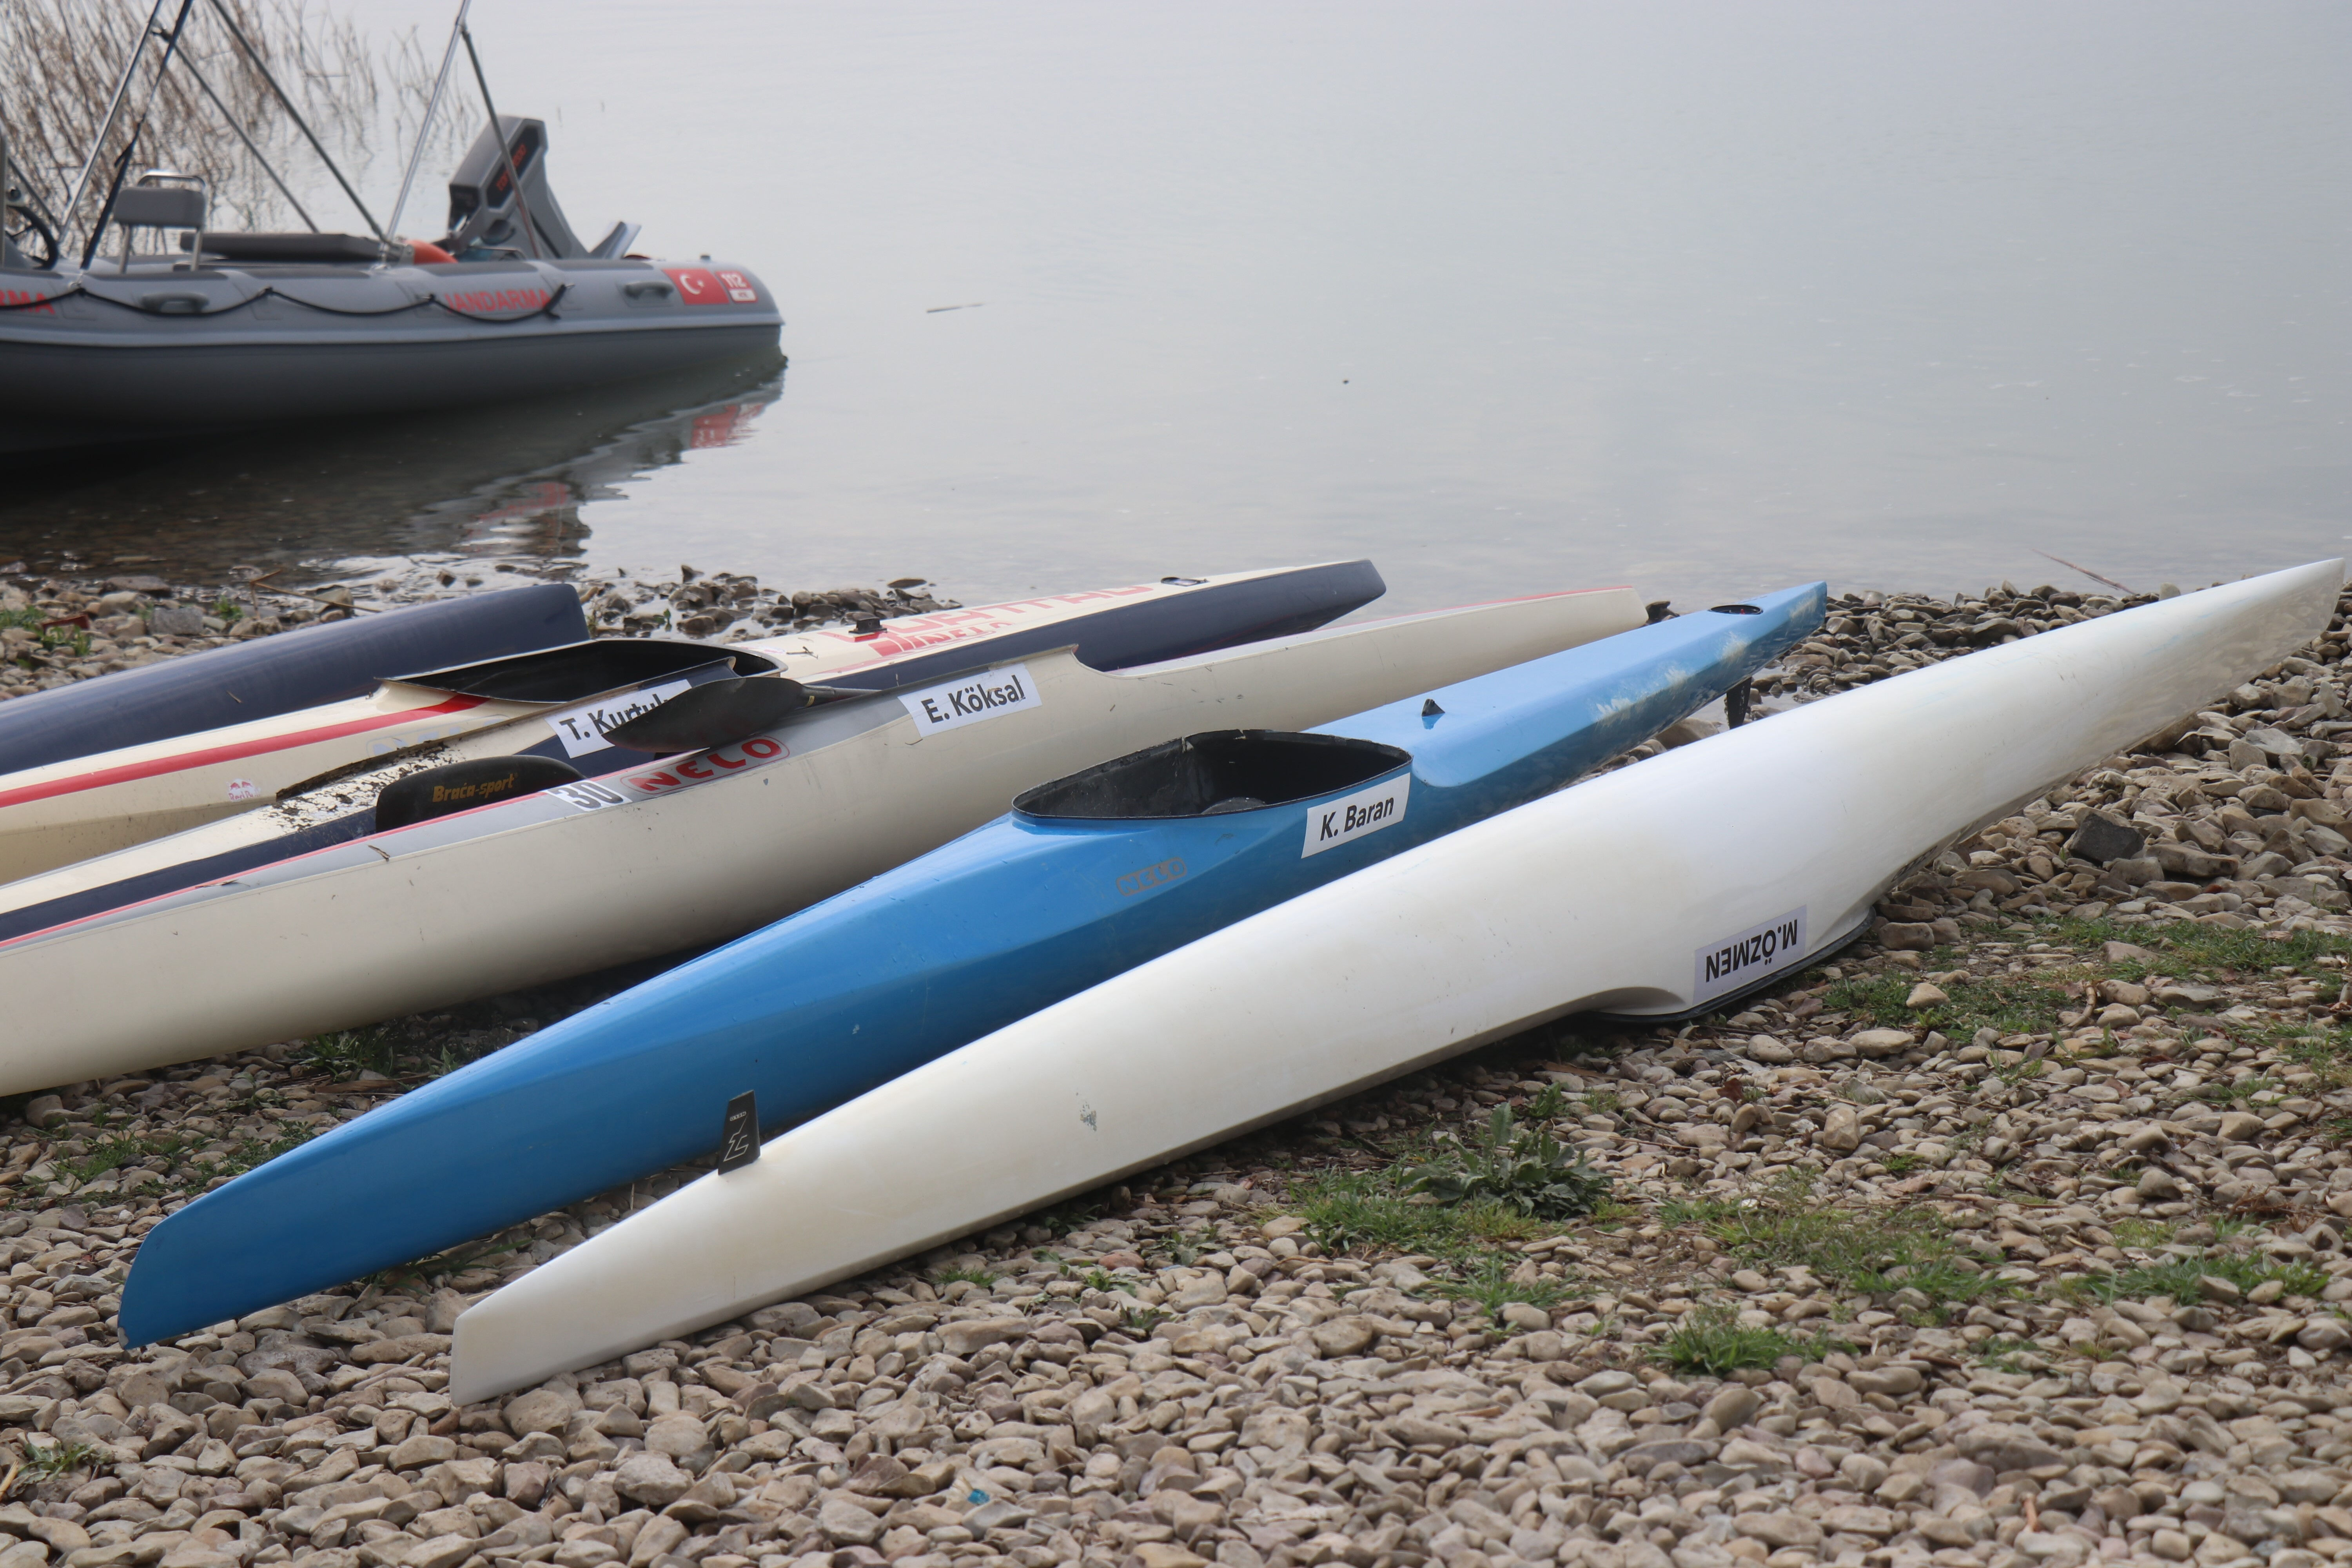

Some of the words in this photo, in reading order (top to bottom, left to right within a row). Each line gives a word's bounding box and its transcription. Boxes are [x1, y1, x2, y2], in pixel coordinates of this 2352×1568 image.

[720, 272, 747, 288] 112
[445, 288, 551, 313] JANDARMA
[921, 698, 950, 724] E.
[947, 674, 1026, 717] Köksal
[558, 717, 590, 740] T.
[628, 739, 782, 791] NELO
[550, 781, 624, 809] 30
[1319, 811, 1339, 842] K.
[1343, 797, 1394, 833] Baran
[1119, 860, 1184, 894] NELO
[1705, 919, 1798, 983] M.ÖZMEN
